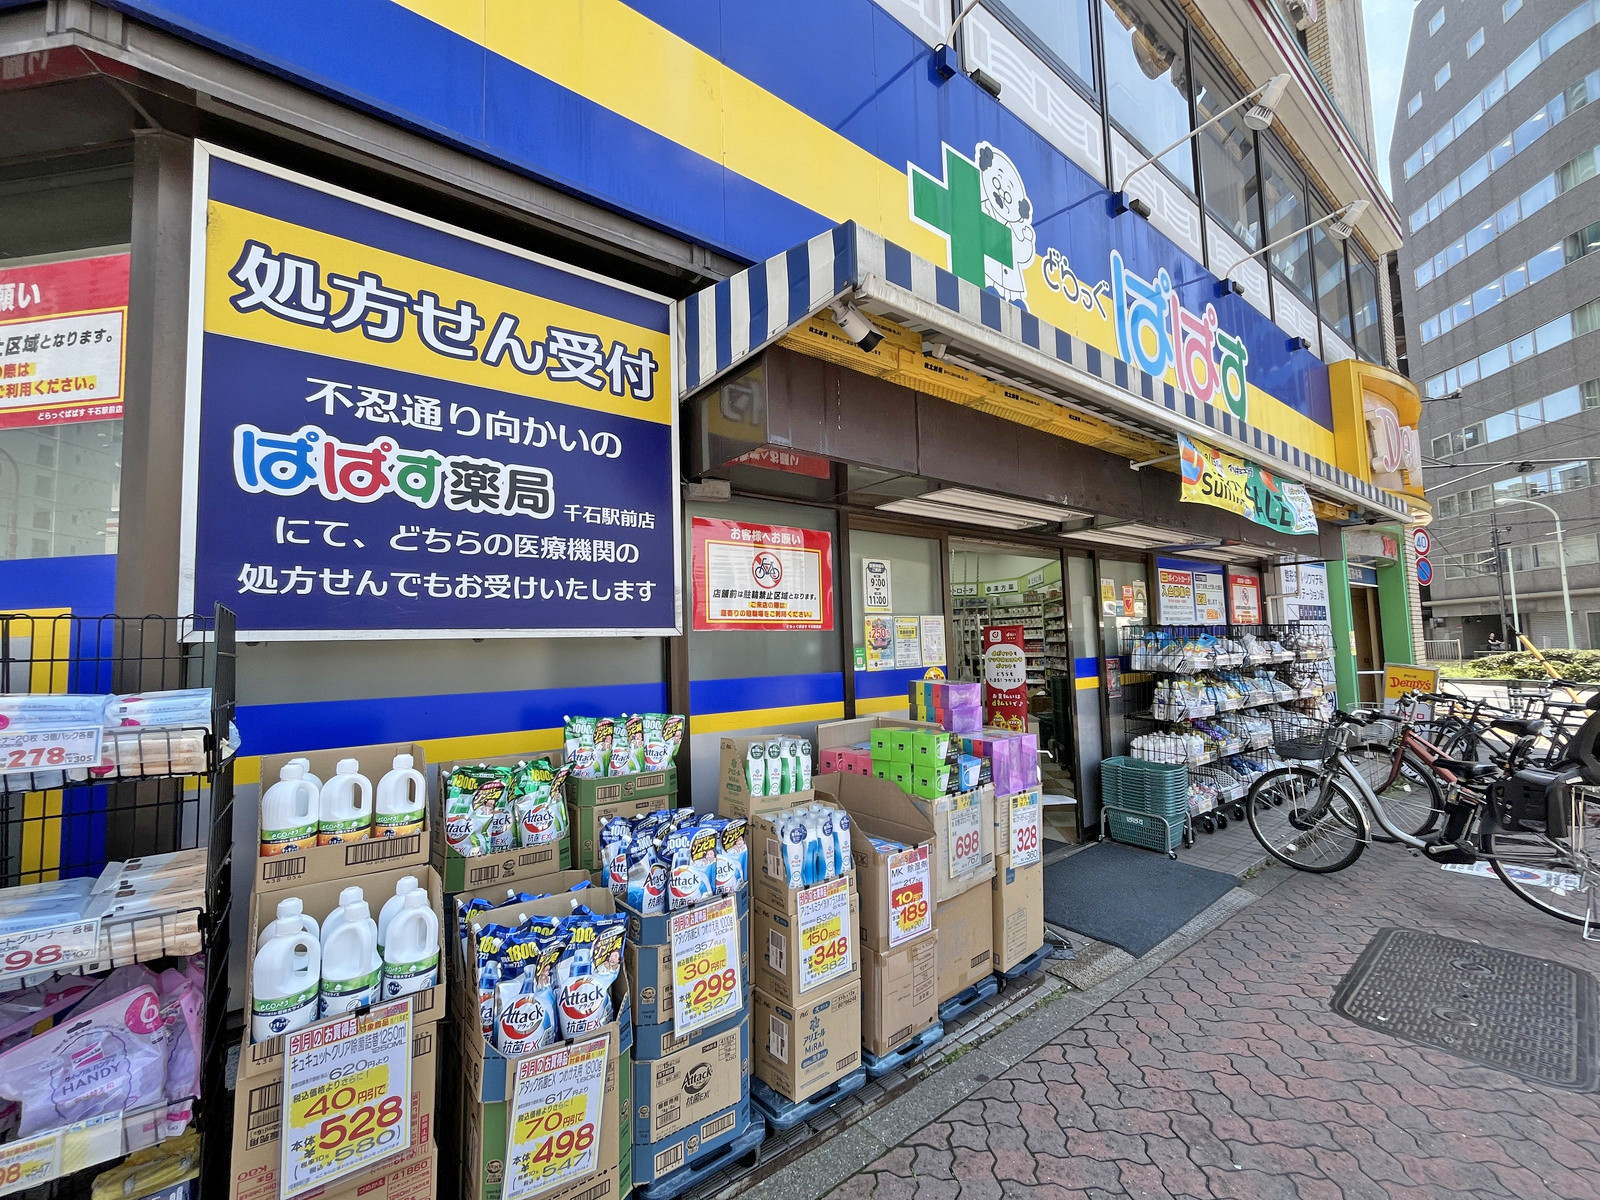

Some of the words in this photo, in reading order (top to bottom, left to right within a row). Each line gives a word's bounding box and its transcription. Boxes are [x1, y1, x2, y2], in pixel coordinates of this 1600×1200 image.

[229, 240, 657, 400] 処方せん受付
[0, 328, 113, 356] 区域となります。
[1041, 247, 1110, 321] どらっぐ
[1110, 249, 1248, 423] ぱぱす
[305, 377, 622, 459] 不忍通り向かいの
[234, 424, 554, 519] ぱぱす薬局
[563, 505, 655, 530] 千石駅前店
[276, 517, 640, 564] にて、どちらの医療機関の
[730, 528, 802, 545] お客様へお願い
[1416, 536, 1427, 549] 40
[238, 563, 656, 602] 処方せんでもお受けいたします
[870, 578, 886, 587] 9:00
[868, 595, 887, 605] 11:00
[1390, 676, 1432, 691] Denny's
[7, 747, 66, 769] 278
[73, 755, 93, 763] 305
[567, 749, 596, 762] Attack
[522, 809, 554, 823] Attack
[956, 830, 979, 859] 698
[1017, 825, 1038, 852] 328
[610, 861, 627, 873] Atta
[892, 867, 903, 879] MK
[900, 900, 928, 924] 189
[73, 923, 94, 934] 各種
[5, 945, 62, 970] 98
[506, 941, 539, 962] 1800g
[814, 936, 848, 966] 348
[821, 957, 845, 974] 382
[559, 986, 604, 1007] Attack
[693, 968, 737, 1005] 298
[140, 996, 159, 1024] 6
[500, 1003, 544, 1024] Attack
[702, 992, 733, 1013] 327
[290, 1018, 358, 1056] 今月のお買得品
[567, 1020, 600, 1033] 抗菌EX
[803, 1028, 826, 1046] アリエール
[502, 1041, 539, 1054] 抗菌EX
[330, 1055, 389, 1081] 620円より
[520, 1051, 569, 1080] 今月のお買得品
[62, 1061, 120, 1096] HANDY
[681, 1067, 713, 1091] Attack
[303, 1084, 387, 1119] 40円引で
[545, 1086, 589, 1105] 617円より
[319, 1095, 403, 1150] 528
[525, 1111, 585, 1140] 70円引で
[290, 1136, 316, 1152] 本体
[334, 1129, 396, 1162] 580
[532, 1122, 595, 1164] 498
[392, 1160, 428, 1181] 41860
[512, 1152, 531, 1166] 本体
[542, 1151, 588, 1178] 547
[358, 1180, 384, 1194] つめかえ
